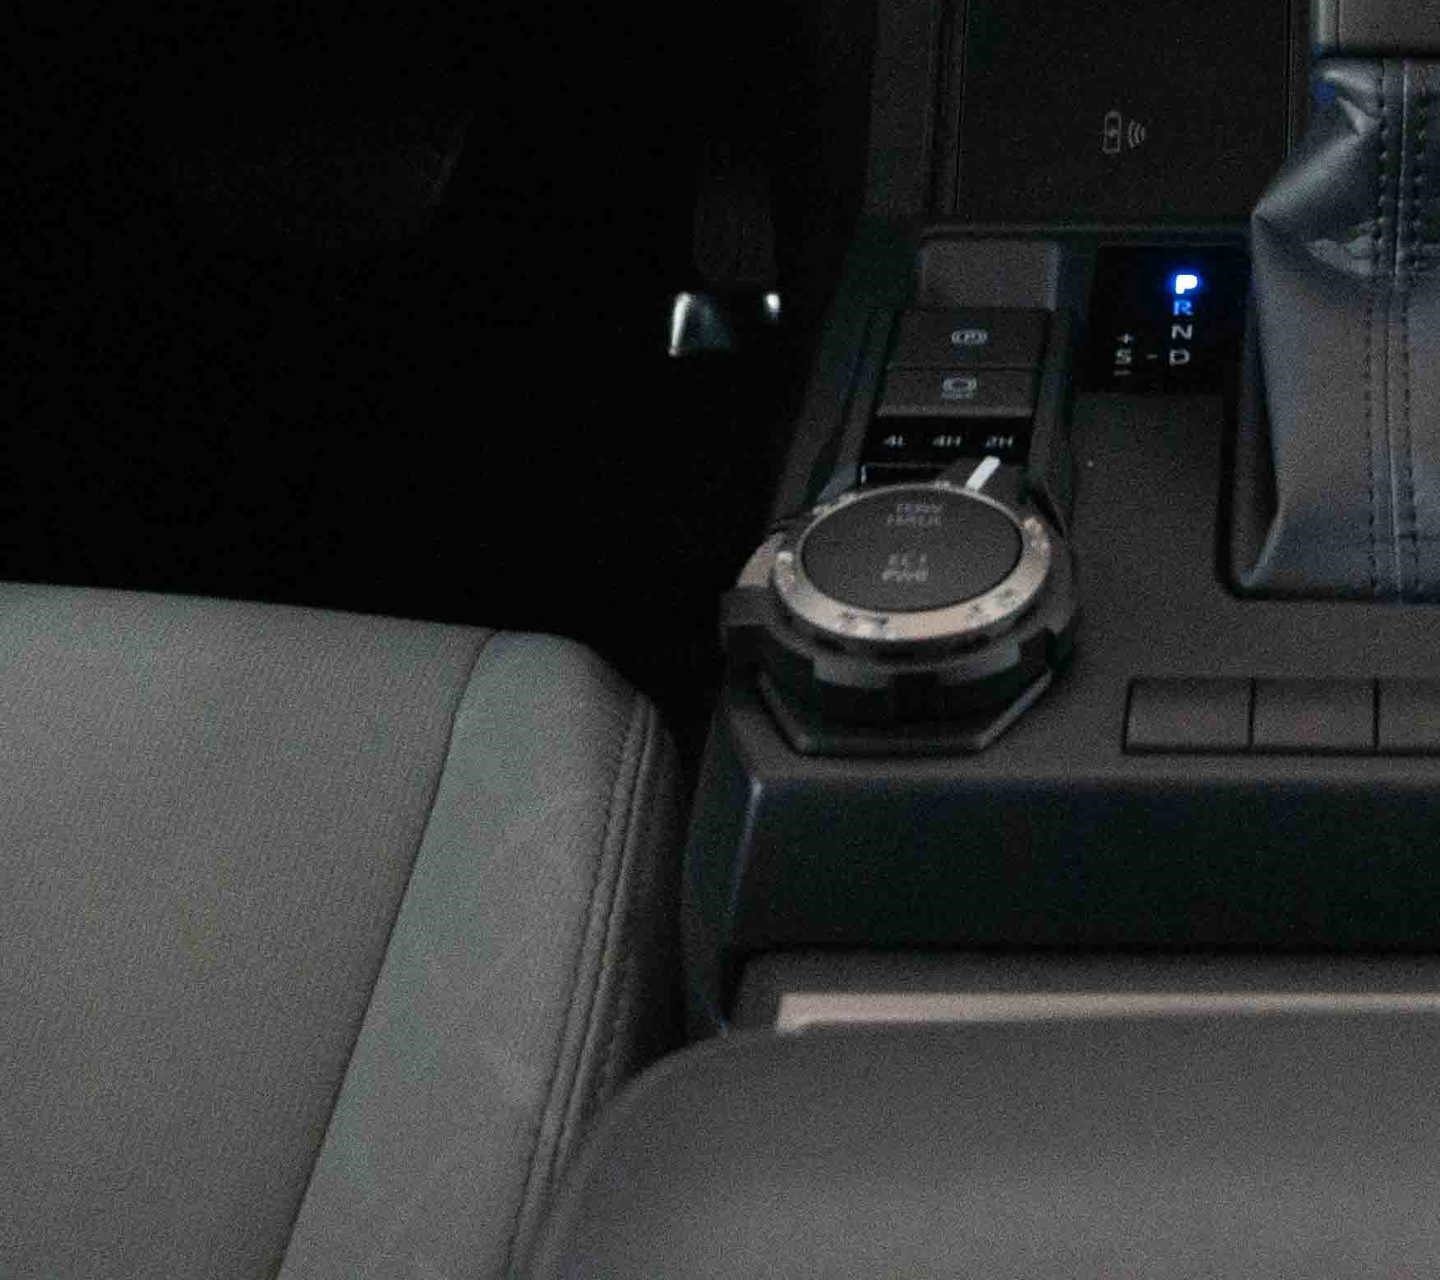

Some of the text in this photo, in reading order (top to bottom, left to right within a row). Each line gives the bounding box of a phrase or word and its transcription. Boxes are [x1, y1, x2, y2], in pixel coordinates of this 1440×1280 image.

[1175, 274, 1198, 295] P
[1172, 299, 1194, 317] R
[1170, 323, 1193, 341] N
[1168, 348, 1192, 367] D
